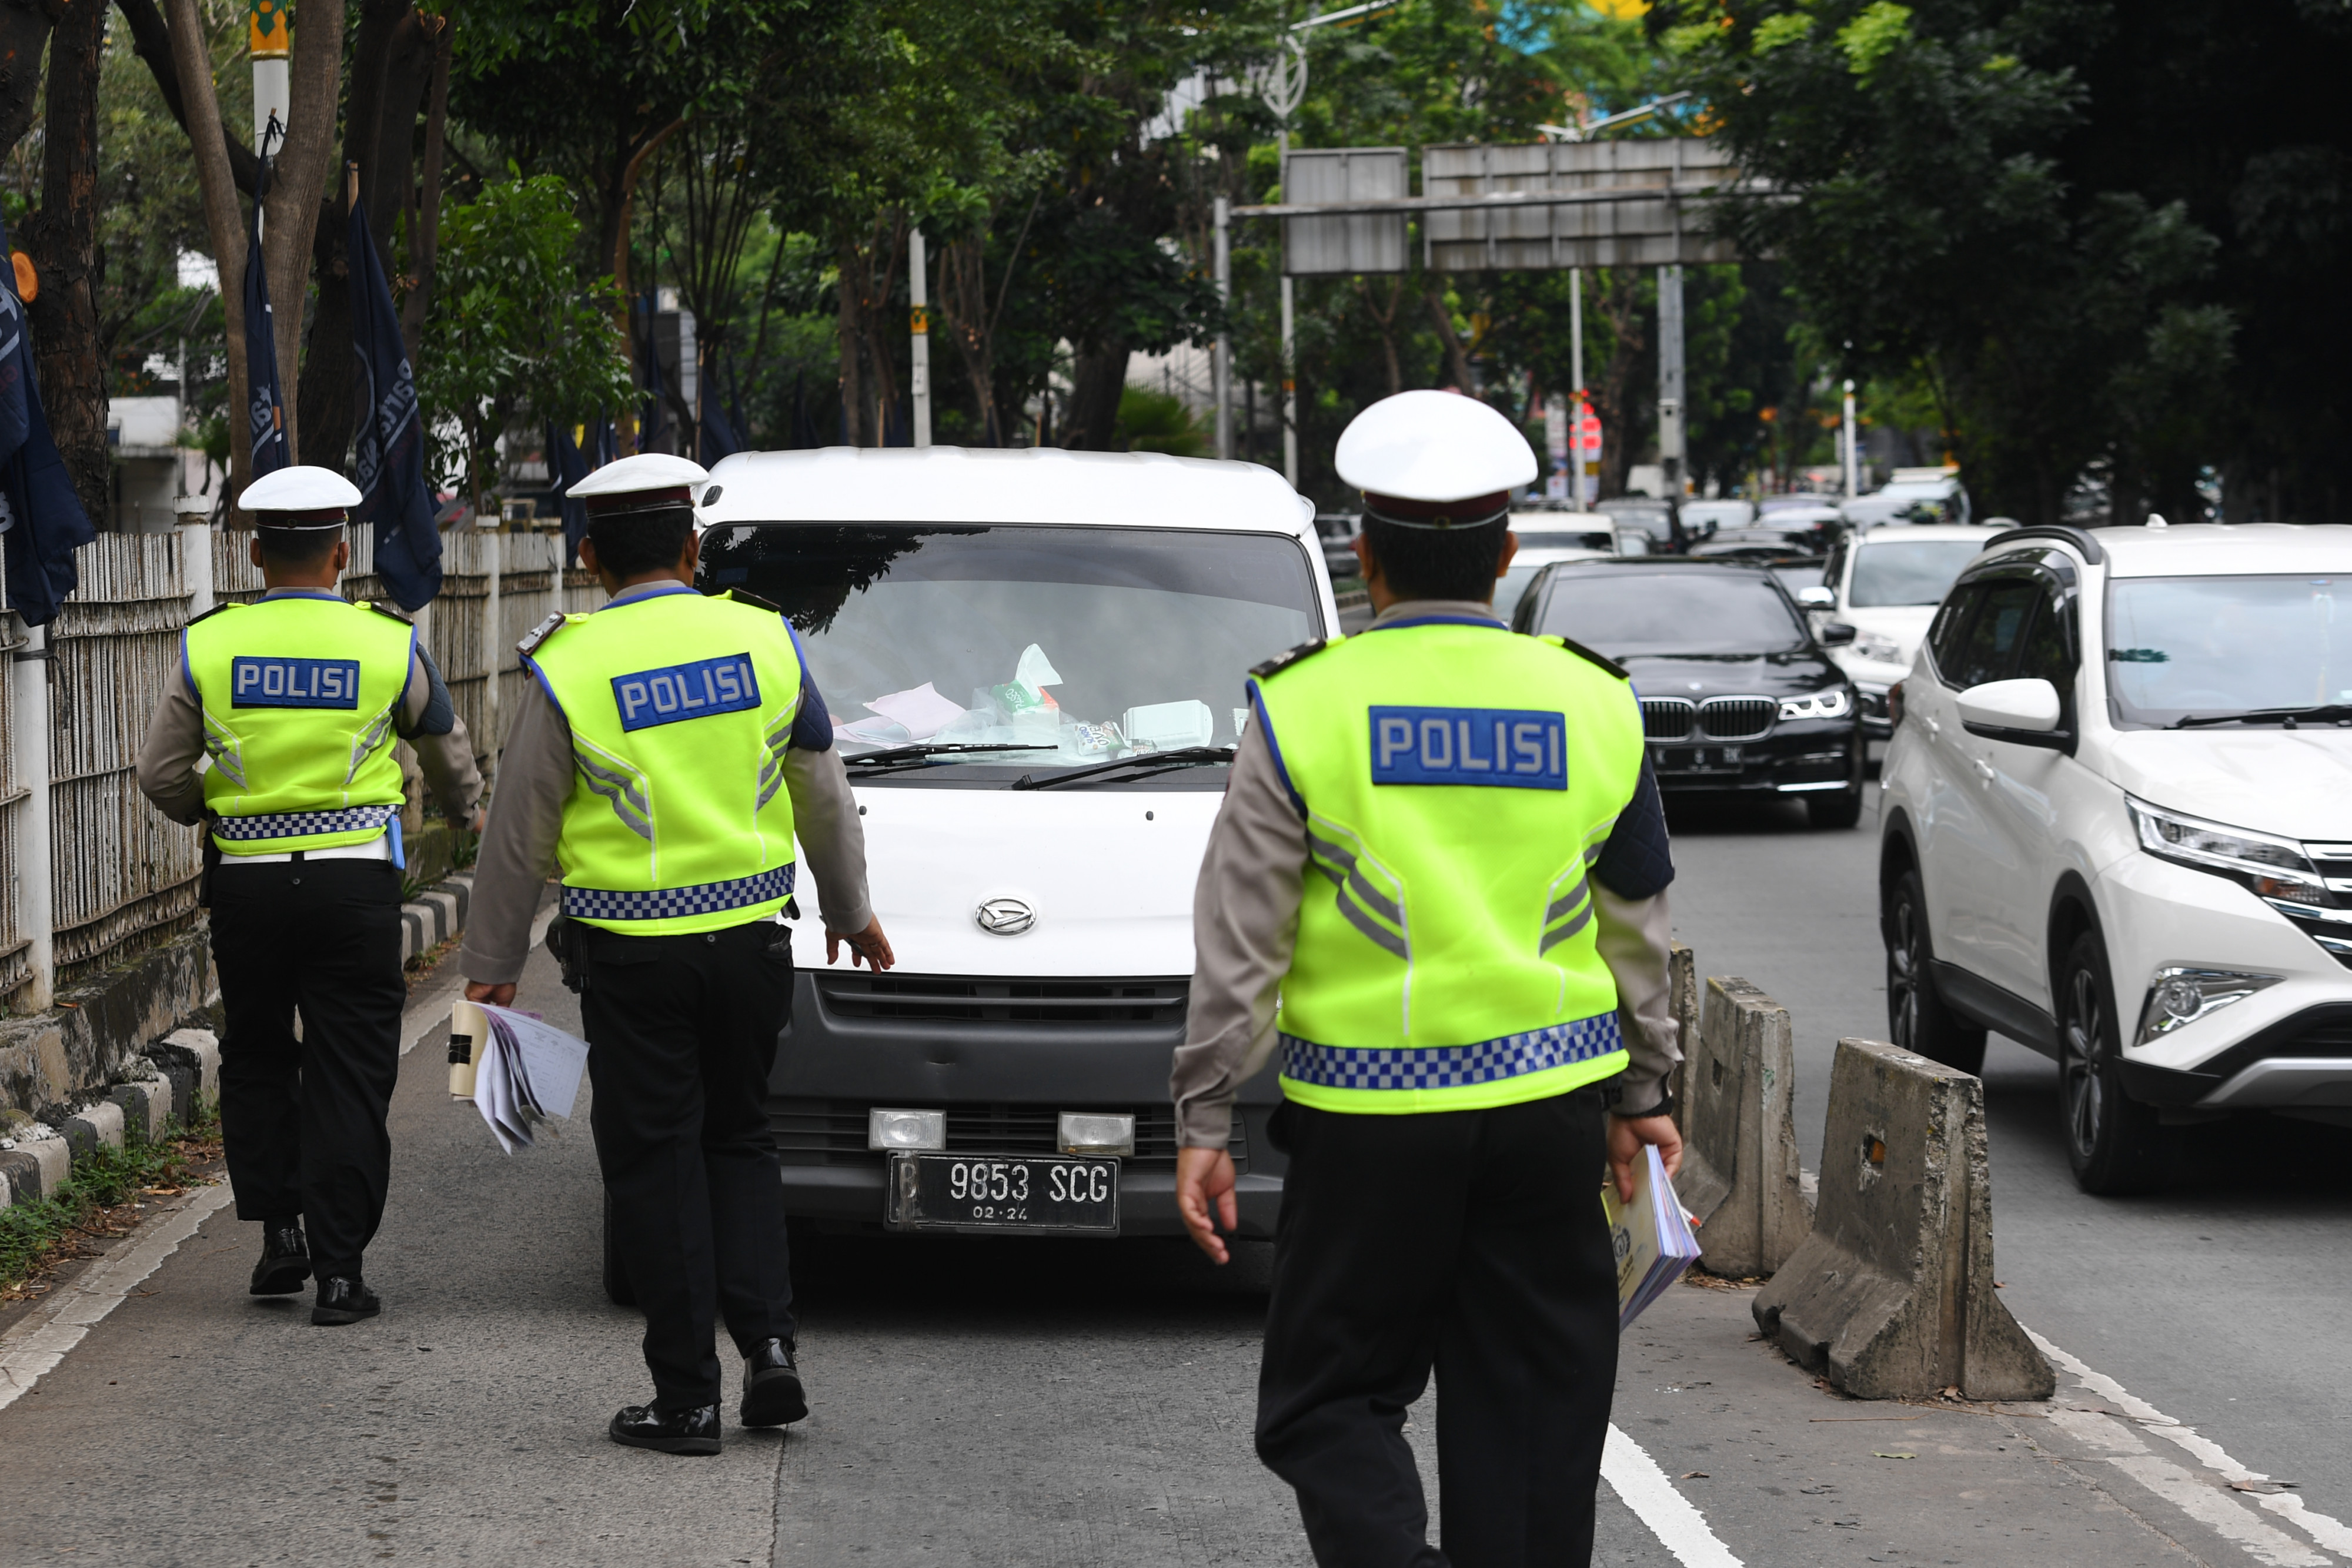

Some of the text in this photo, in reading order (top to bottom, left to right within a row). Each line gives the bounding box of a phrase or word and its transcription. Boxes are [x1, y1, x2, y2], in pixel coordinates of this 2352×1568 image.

[238, 664, 355, 699] POLISI
[621, 662, 756, 720] POLISI
[1379, 717, 1561, 774] POLISI
[950, 1163, 1029, 1201] 9853
[1049, 1165, 1108, 1203] SCG
